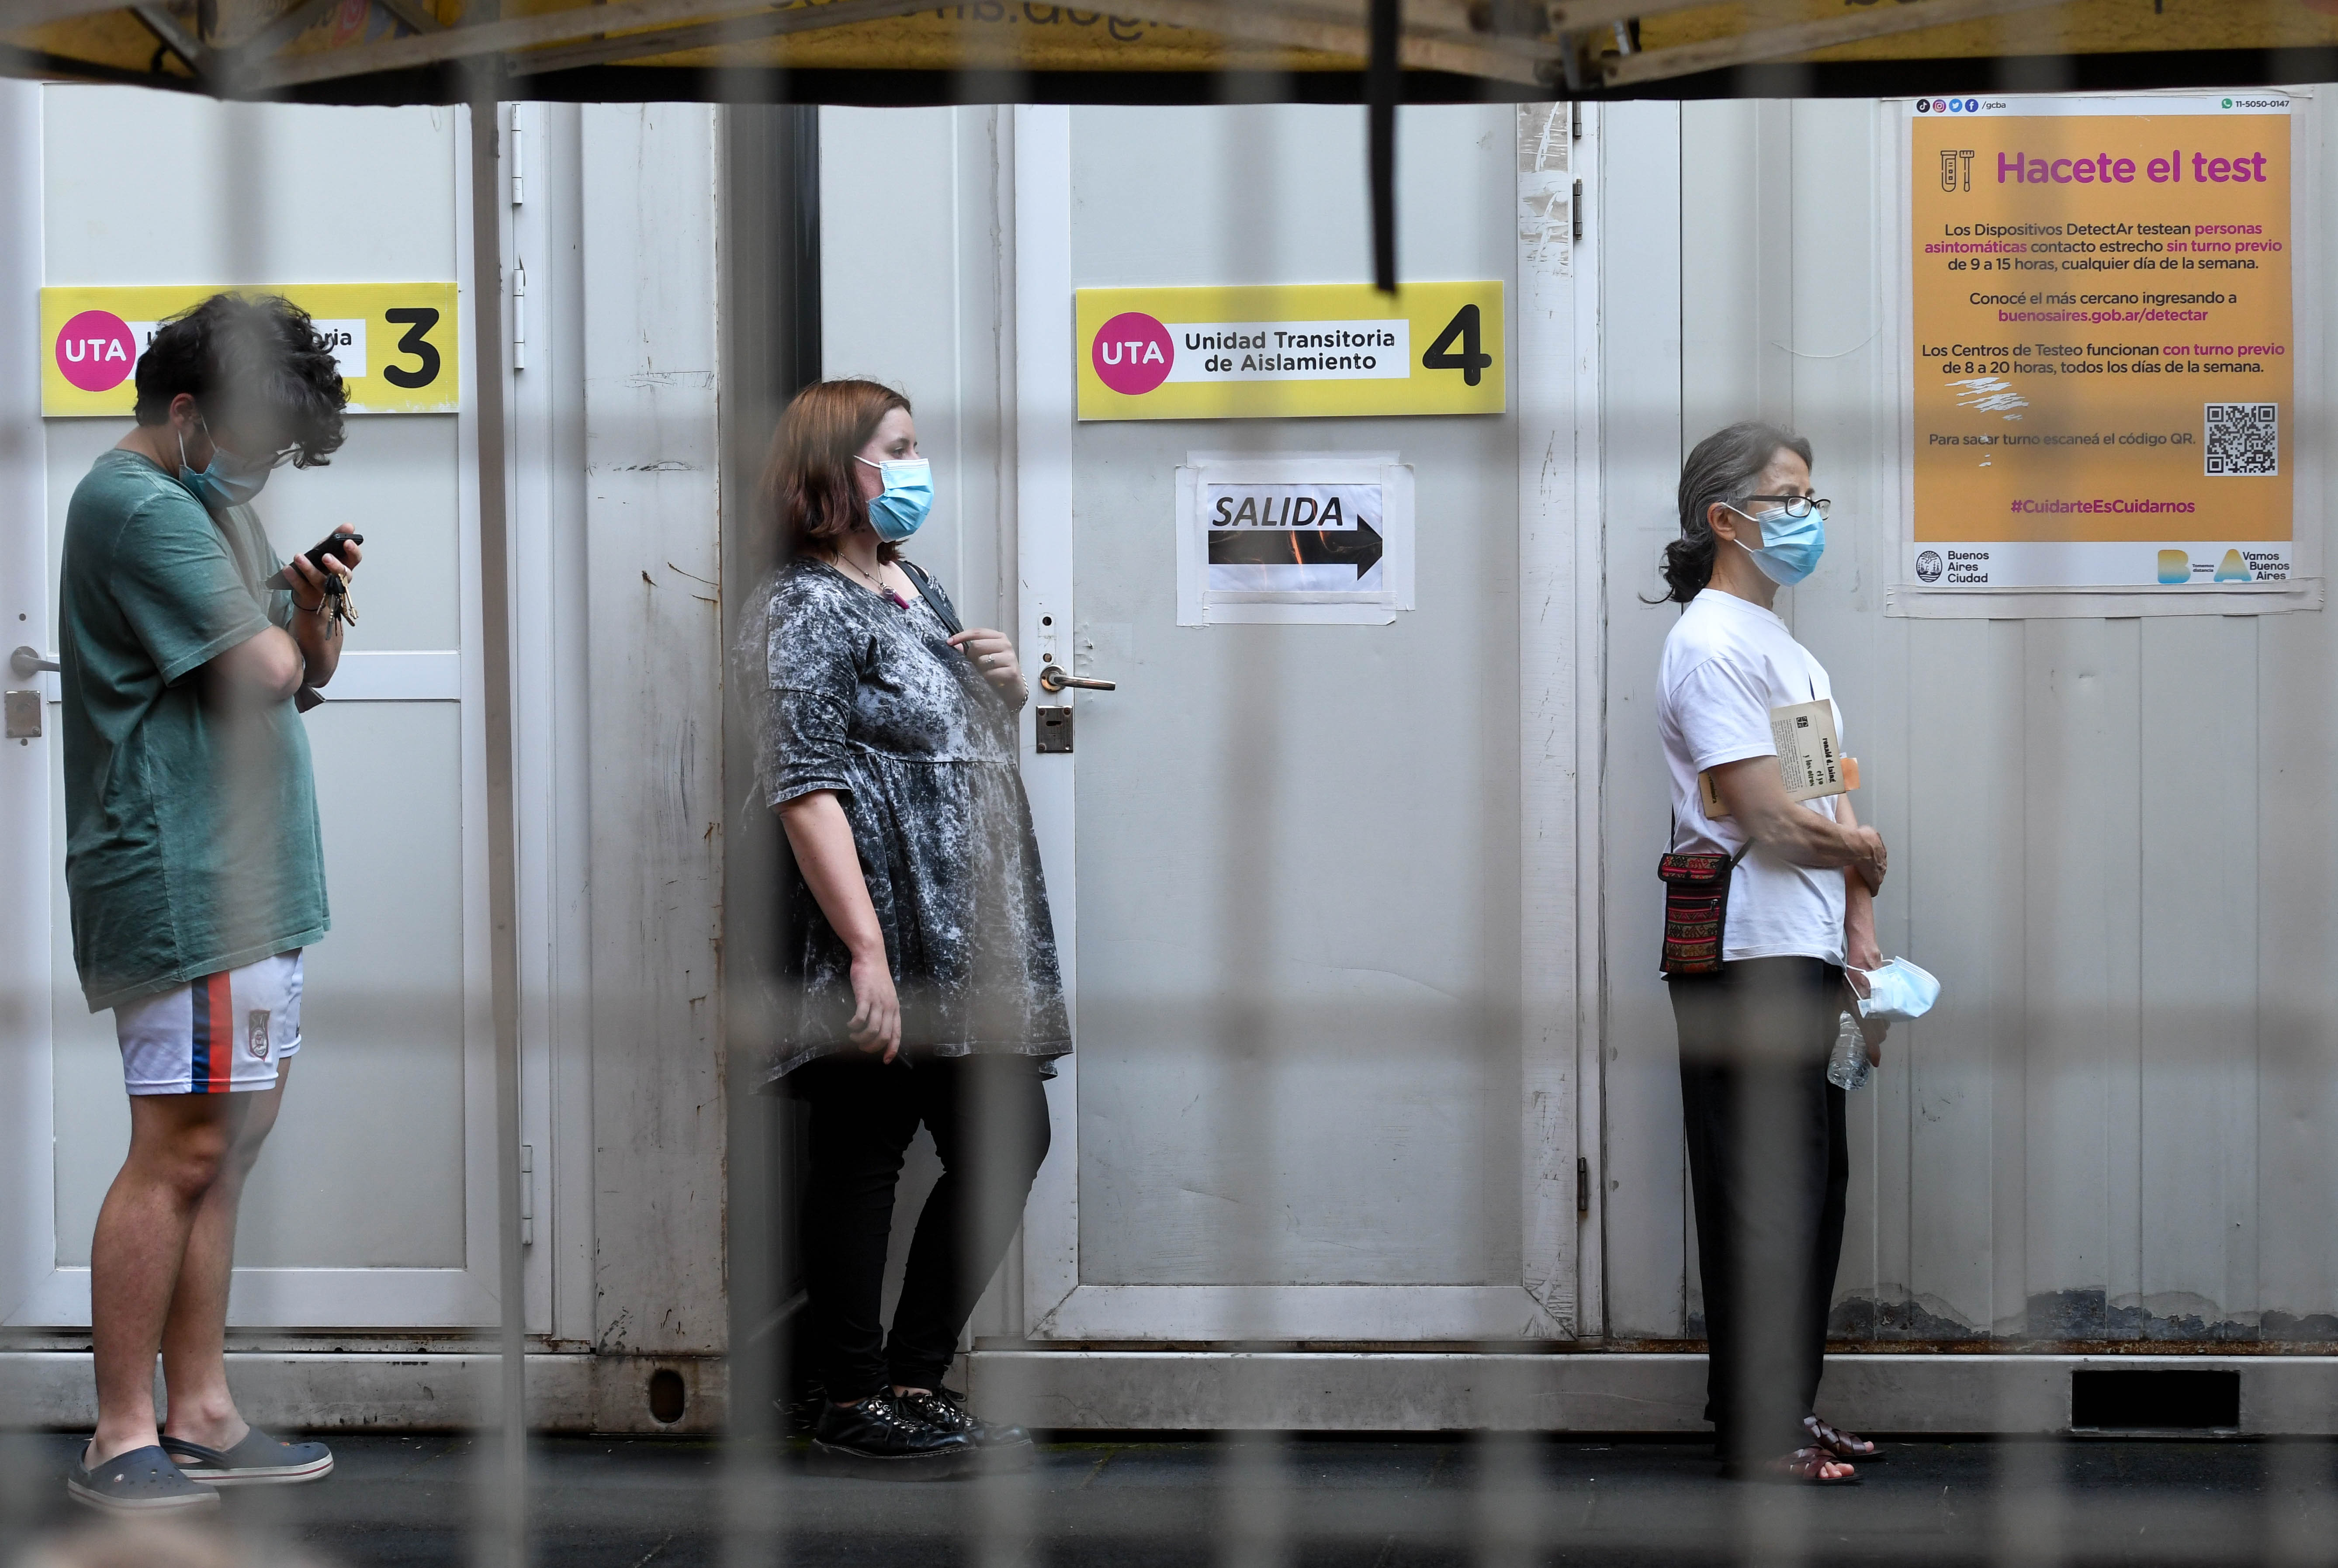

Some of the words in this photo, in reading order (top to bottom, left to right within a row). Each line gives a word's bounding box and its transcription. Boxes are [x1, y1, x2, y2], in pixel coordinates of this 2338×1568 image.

[1981, 101, 2006, 110] /gcba
[1998, 152, 2136, 183] Hacete
[2147, 149, 2180, 183] el
[2191, 152, 2267, 183] test
[1945, 224, 1971, 236] Los
[1975, 223, 2063, 238] Dispositivos
[2067, 223, 2134, 235] DetectAr
[2137, 223, 2191, 235] testean
[2195, 225, 2262, 237] personas
[1925, 240, 2027, 253] asintomáticas
[2030, 241, 2096, 253] contacto
[2099, 239, 2163, 253] estrecho
[2167, 239, 2187, 252] sin
[2191, 240, 2231, 252] turno
[2235, 239, 2283, 254] previo
[1948, 258, 1967, 270] de
[1971, 258, 1980, 270] 9
[1984, 261, 1992, 270] a
[1996, 258, 2011, 270] 15
[2015, 257, 2057, 272] horas,
[2061, 257, 2130, 272] cualquier
[2133, 256, 2155, 270] día
[2159, 257, 2179, 270] de
[2182, 256, 2194, 269] la
[2198, 260, 2258, 269] semana.
[1970, 291, 2026, 305] Conocé
[2030, 292, 2042, 305] el
[2046, 291, 2076, 305] más
[2080, 294, 2139, 304] cercano
[2143, 291, 2225, 306] ingresando
[2228, 294, 2237, 304] a
[1999, 307, 2208, 324] buenosaires.gob.ar/detectar
[1185, 331, 1265, 350] Unidad
[1274, 329, 1395, 349] Transitoria
[1422, 304, 1492, 387] 4
[66, 339, 127, 362] UTA
[383, 308, 440, 389] 3
[1102, 341, 1164, 365] UTA
[1922, 344, 1948, 357] Los
[1951, 344, 2009, 357] Centros
[2012, 343, 2031, 356] de
[2035, 344, 2083, 356] Testeo
[2086, 343, 2159, 356] funcionan
[2163, 346, 2190, 356] con
[2193, 344, 2234, 356] turno
[2238, 342, 2285, 358] previo
[1205, 354, 1233, 372] de
[1240, 352, 1376, 371] Aislamiento
[1942, 361, 1961, 374] de
[1965, 361, 1974, 374] 8
[1978, 364, 1986, 374] a
[1990, 361, 2010, 374] 20
[2014, 361, 2057, 375] horas,
[2061, 360, 2103, 373] todos
[2107, 360, 2128, 373] los
[2131, 360, 2161, 373] días
[2165, 360, 2184, 373] de
[2188, 360, 2199, 373] la
[2203, 363, 2264, 373] semana.
[1929, 433, 1960, 445] Para
[2002, 434, 2040, 445] turno
[2043, 433, 2099, 445] escaneá
[2103, 433, 2115, 445] el
[2118, 432, 2167, 447] código
[2170, 433, 2196, 444] QR.
[1212, 497, 1343, 527] SALIDA
[2010, 499, 2195, 513] #CuidarteEsCuidarnos
[1948, 550, 1989, 560] Buenos
[2242, 551, 2279, 561] Vamos
[1947, 562, 1978, 571] Aires
[2249, 561, 2290, 571] Buenos
[1947, 573, 1988, 583] Ciudad
[2256, 571, 2286, 580] Aires
[1822, 737, 1833, 758] ronald
[1827, 766, 1836, 784] laing
